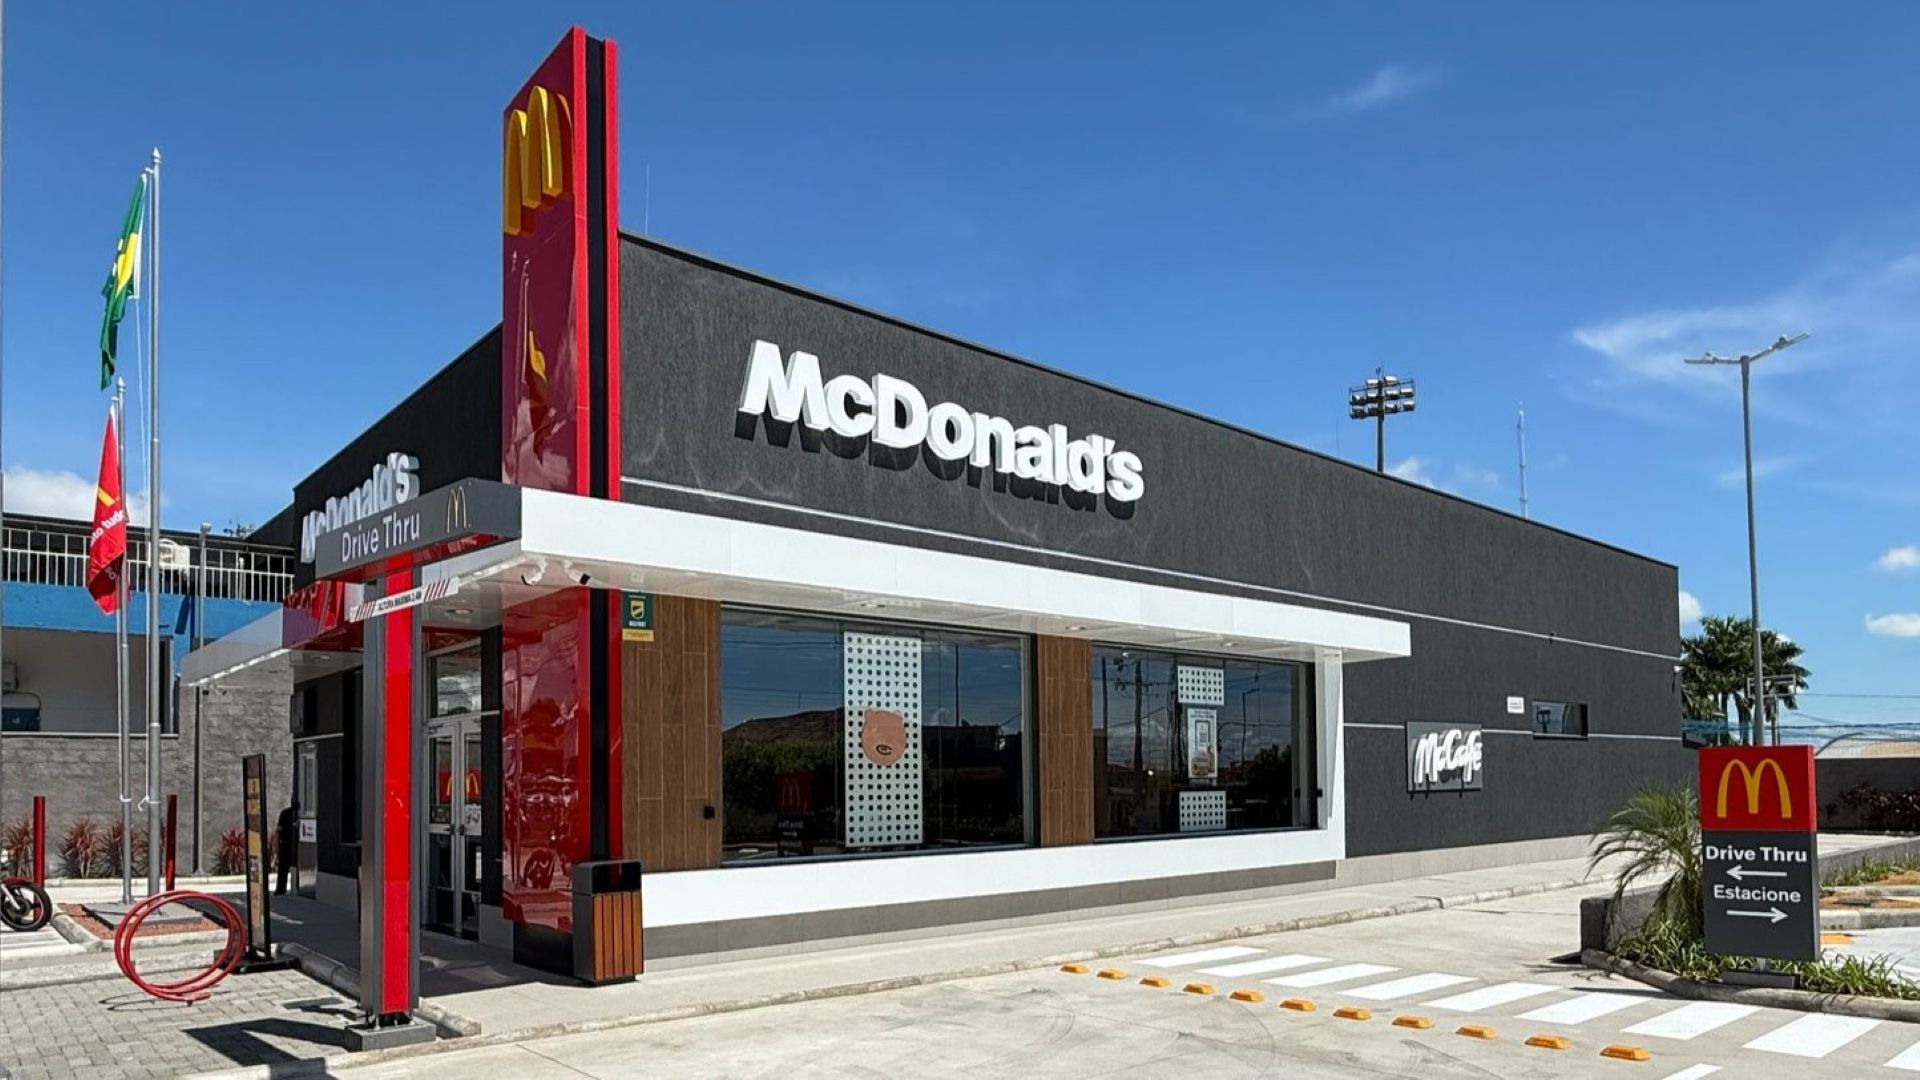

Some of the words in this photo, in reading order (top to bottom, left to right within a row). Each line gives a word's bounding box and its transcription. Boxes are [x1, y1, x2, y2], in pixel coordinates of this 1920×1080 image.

[738, 339, 1145, 502] McDonald's
[342, 525, 379, 562] Drive
[382, 511, 421, 549] Thru
[1705, 844, 1756, 861] Drive
[1760, 846, 1808, 863] Thru
[1713, 884, 1802, 903] Estacione
